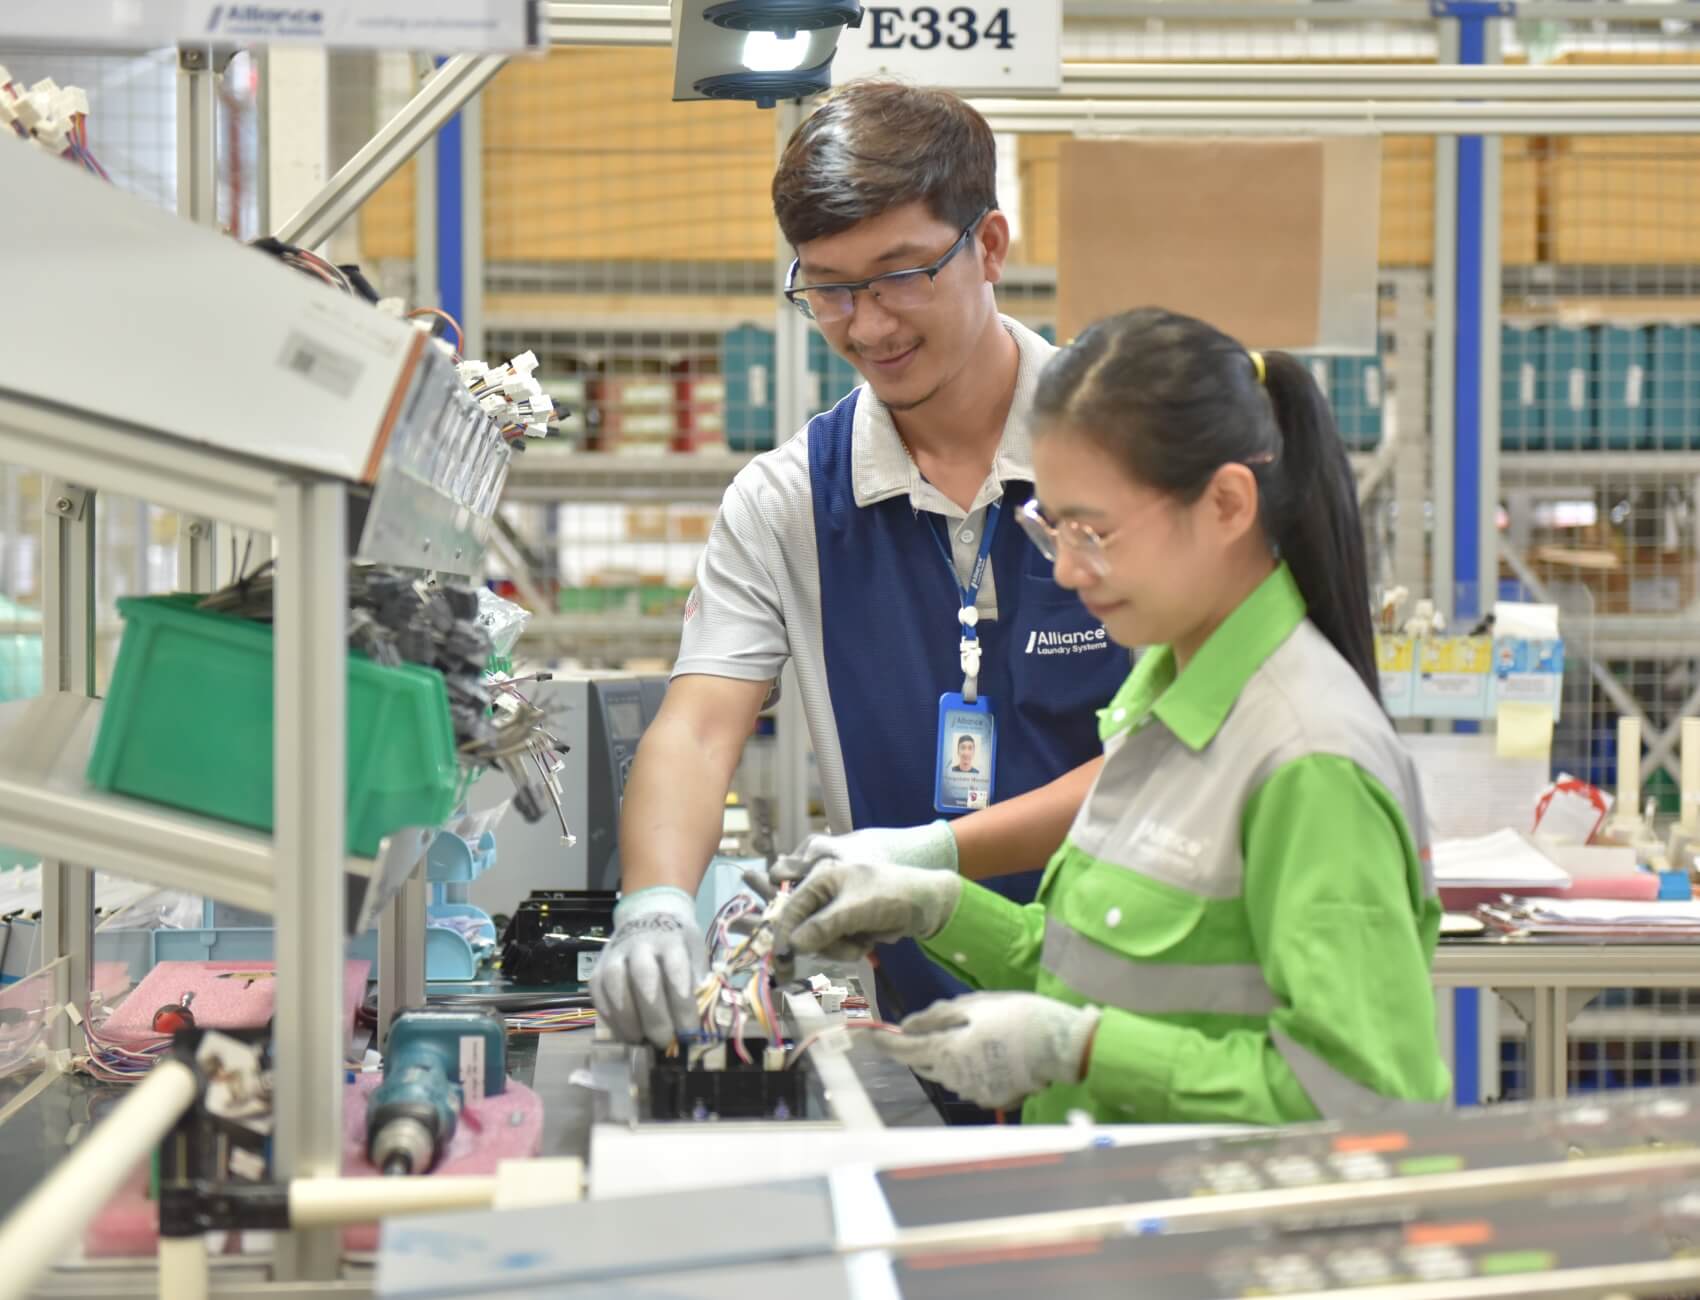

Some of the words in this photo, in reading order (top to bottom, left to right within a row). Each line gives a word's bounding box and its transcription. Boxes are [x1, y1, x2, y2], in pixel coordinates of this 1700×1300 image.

[867, 6, 1016, 49] E334
[1038, 628, 1105, 645] Alliance
[1037, 645, 1071, 655] Laundry
[1072, 642, 1107, 653] Systems
